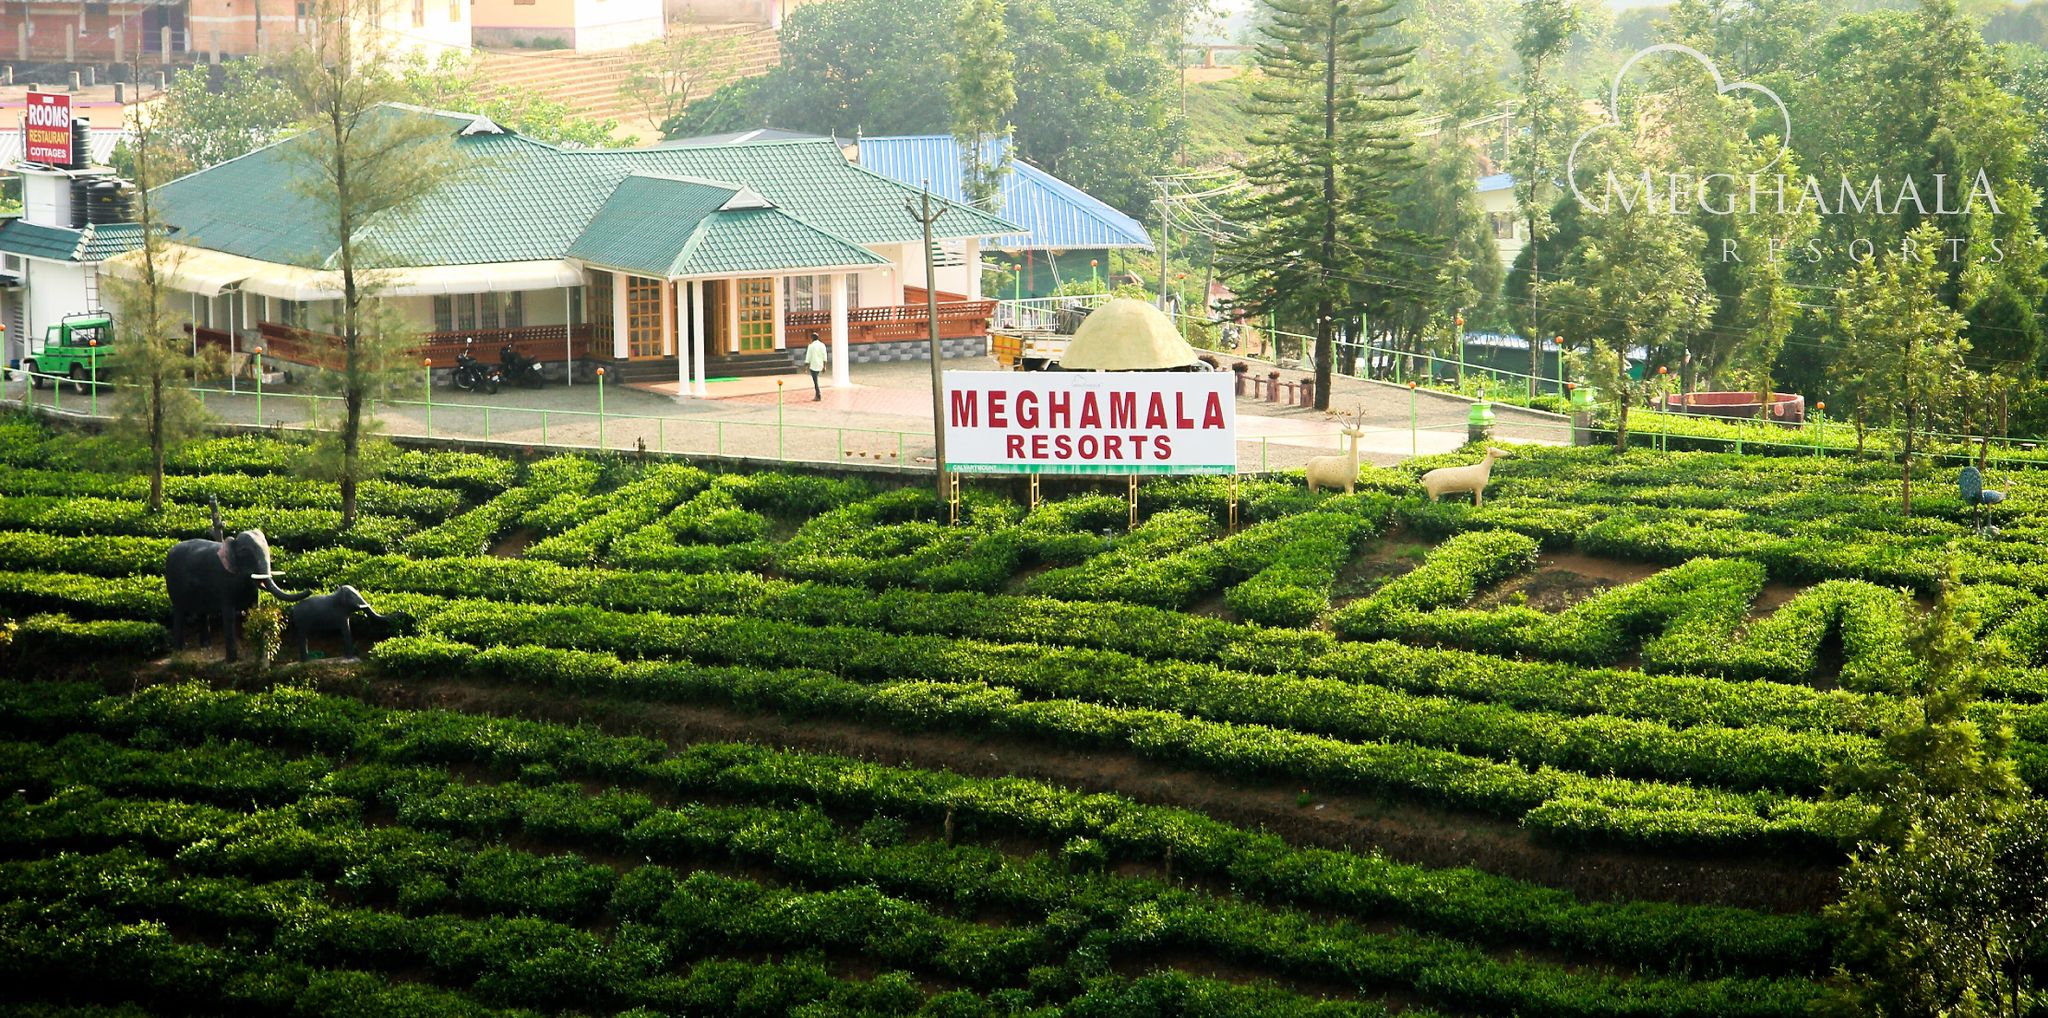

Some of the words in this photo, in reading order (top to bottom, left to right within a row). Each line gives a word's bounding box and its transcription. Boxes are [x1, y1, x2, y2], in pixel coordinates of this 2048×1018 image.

[28, 104, 69, 128] ROOMS
[28, 129, 69, 145] RESTAURANT
[30, 147, 67, 159] COTTAGES
[950, 389, 1226, 430] MEGHAMALA
[1006, 434, 1172, 460] RESORTS
